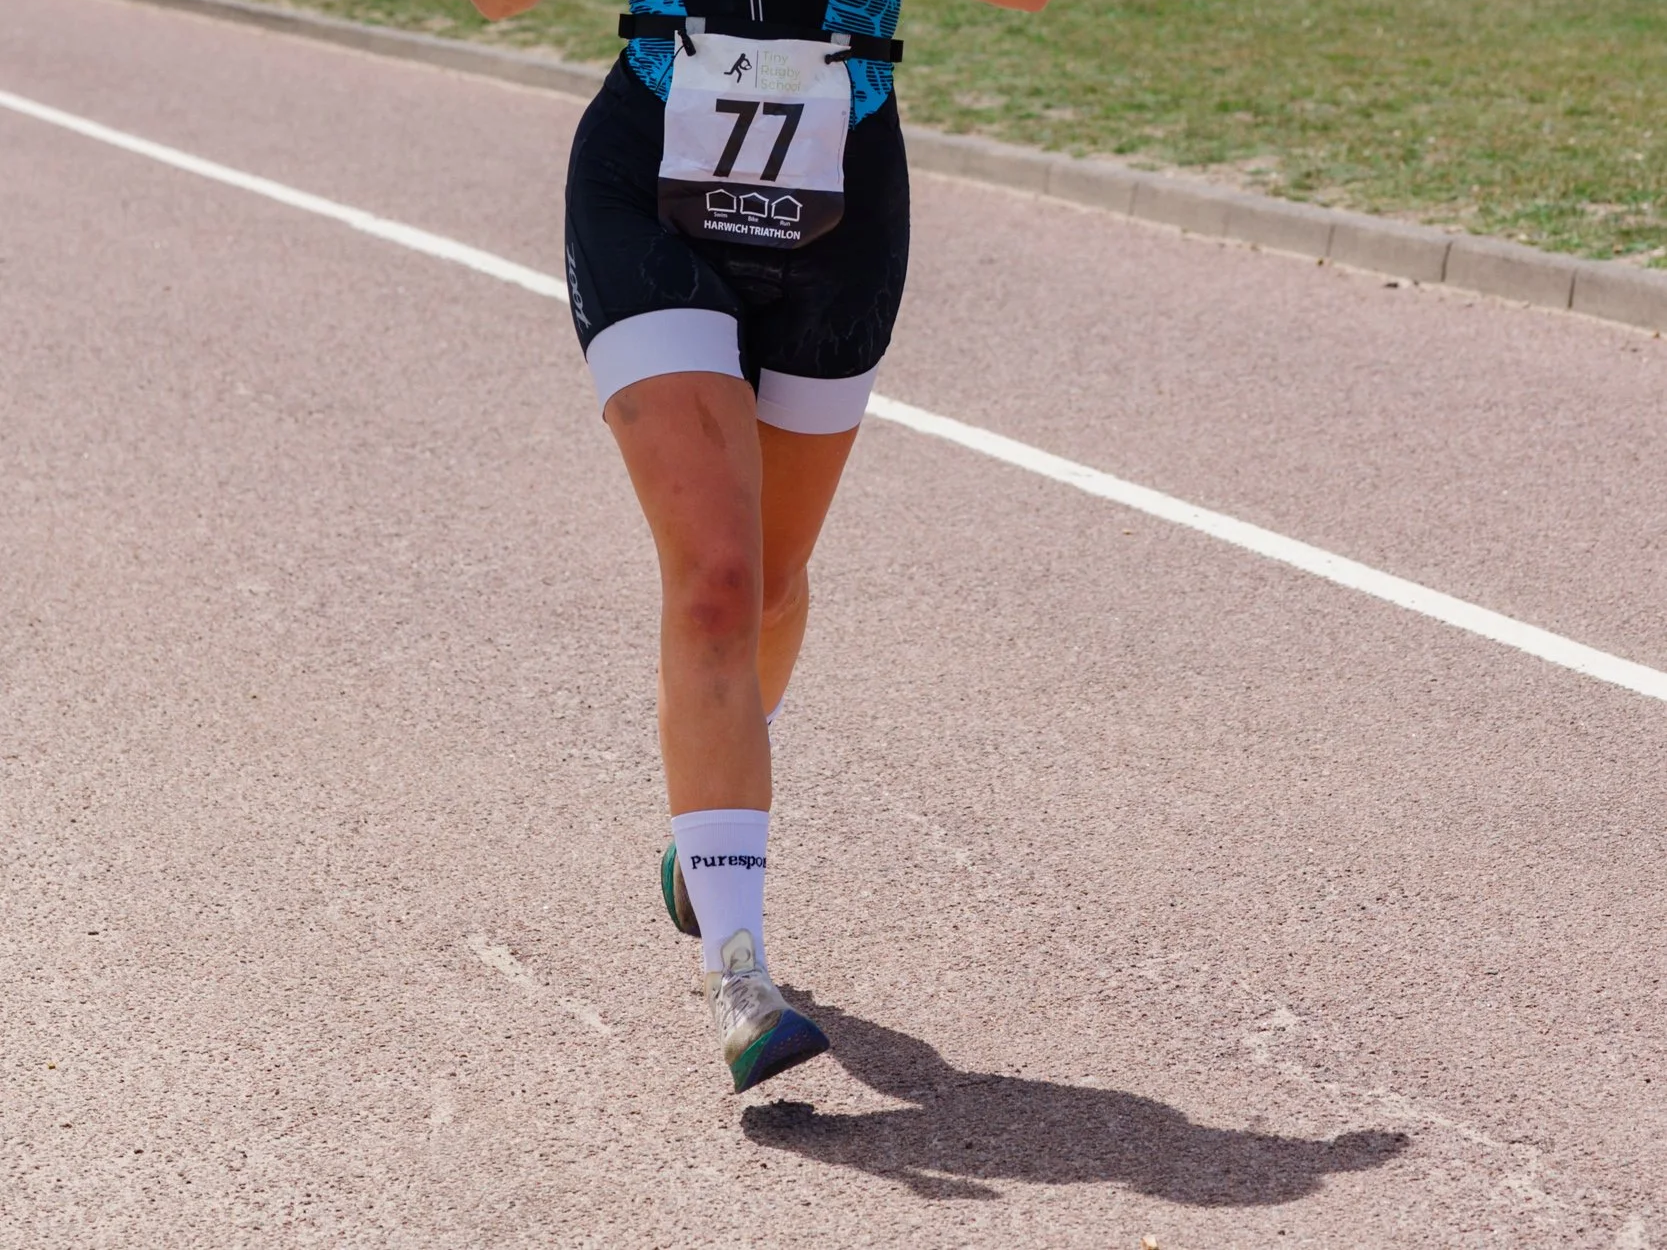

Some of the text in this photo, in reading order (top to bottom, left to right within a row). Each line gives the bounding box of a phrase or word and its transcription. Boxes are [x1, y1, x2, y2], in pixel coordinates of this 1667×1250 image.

[763, 51, 789, 65] Tiny
[761, 65, 800, 80] Rugby
[761, 78, 801, 92] School
[713, 98, 805, 182] 77
[713, 211, 728, 219] Swim
[704, 220, 801, 240] HARWICH TRIATHLON
